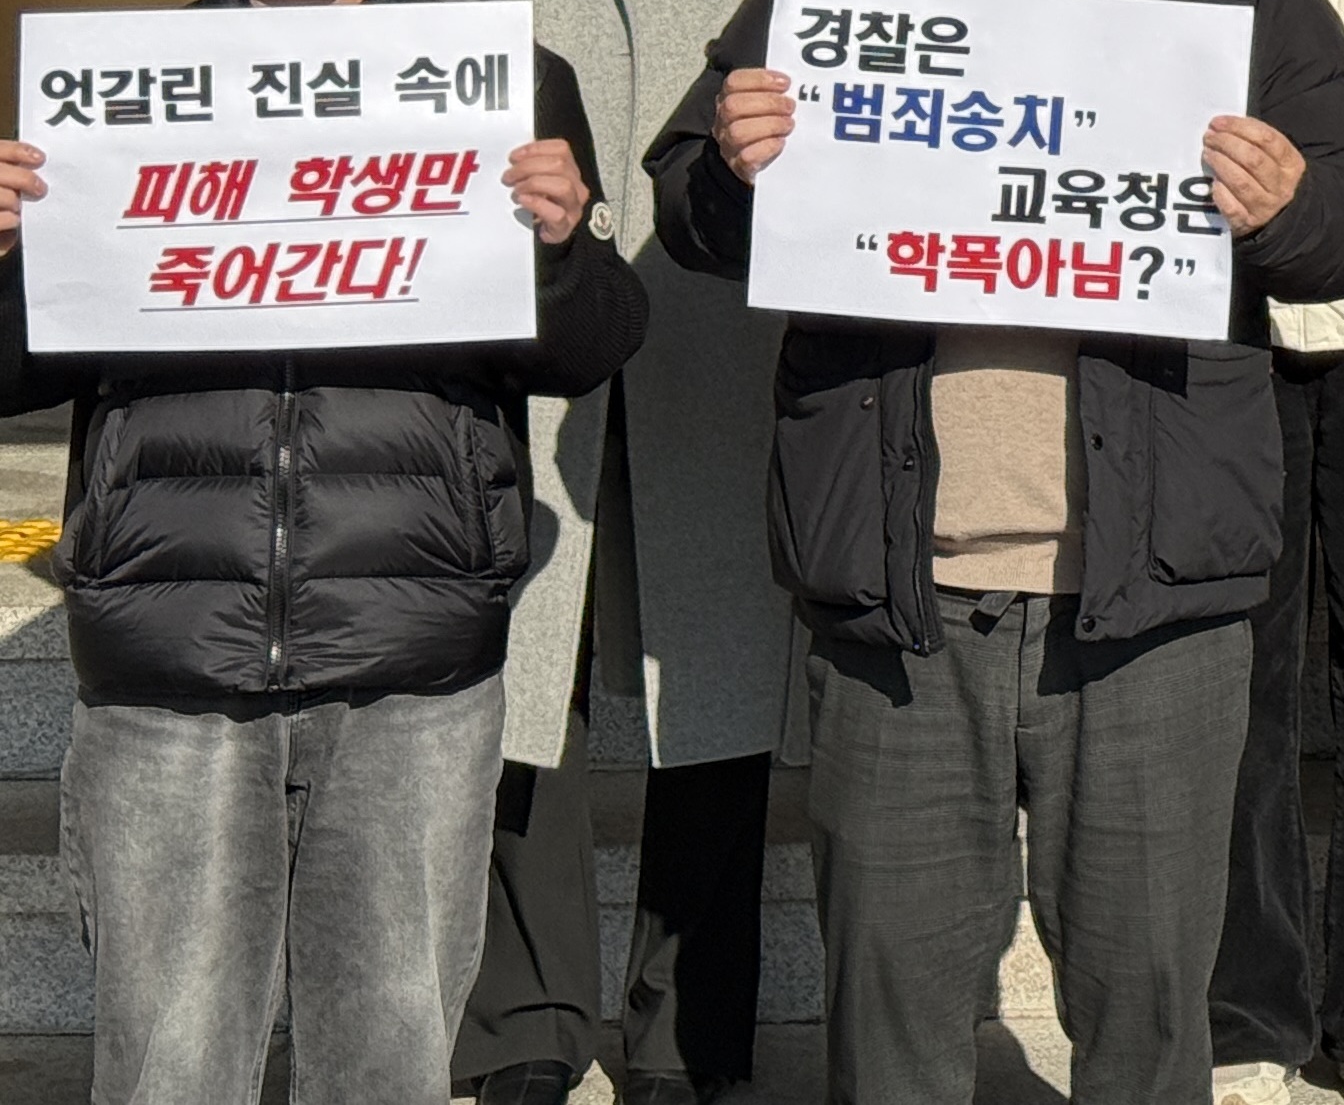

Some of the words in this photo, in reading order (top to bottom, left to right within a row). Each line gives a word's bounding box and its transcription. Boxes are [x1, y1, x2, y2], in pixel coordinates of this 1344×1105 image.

[796, 8, 970, 76] 경찰은
[41, 65, 213, 127] 엇갈린
[248, 60, 362, 119] 진실
[395, 53, 509, 113] 속에
[798, 83, 1096, 156] “범죄송치”
[123, 160, 257, 221] 피해
[287, 150, 478, 215] 학생만
[991, 166, 1225, 236] 교육청은
[149, 237, 427, 305] 죽어간다!
